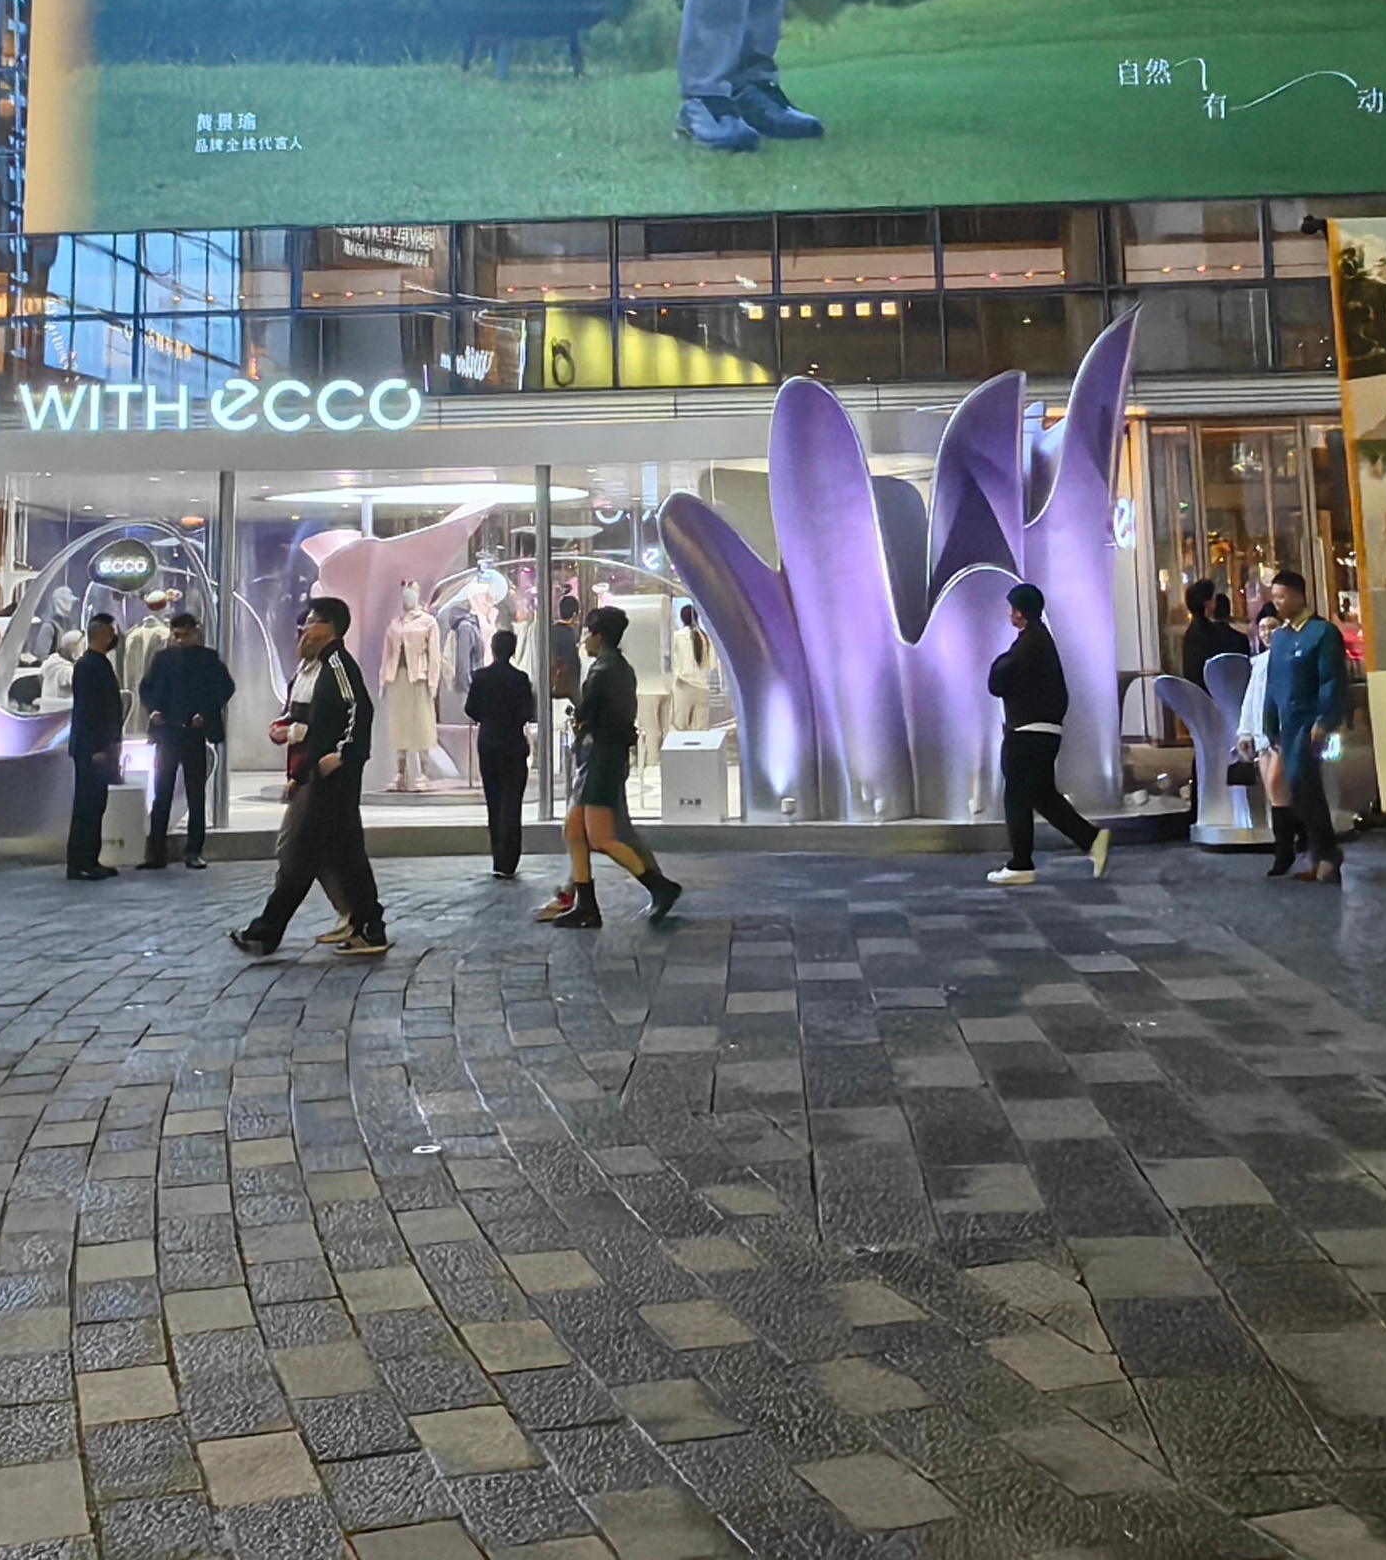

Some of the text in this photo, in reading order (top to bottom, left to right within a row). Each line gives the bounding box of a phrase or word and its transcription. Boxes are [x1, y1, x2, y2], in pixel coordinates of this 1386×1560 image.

[1118, 57, 1172, 86] 自然
[19, 382, 188, 432] WITH
[211, 378, 422, 432] ecco
